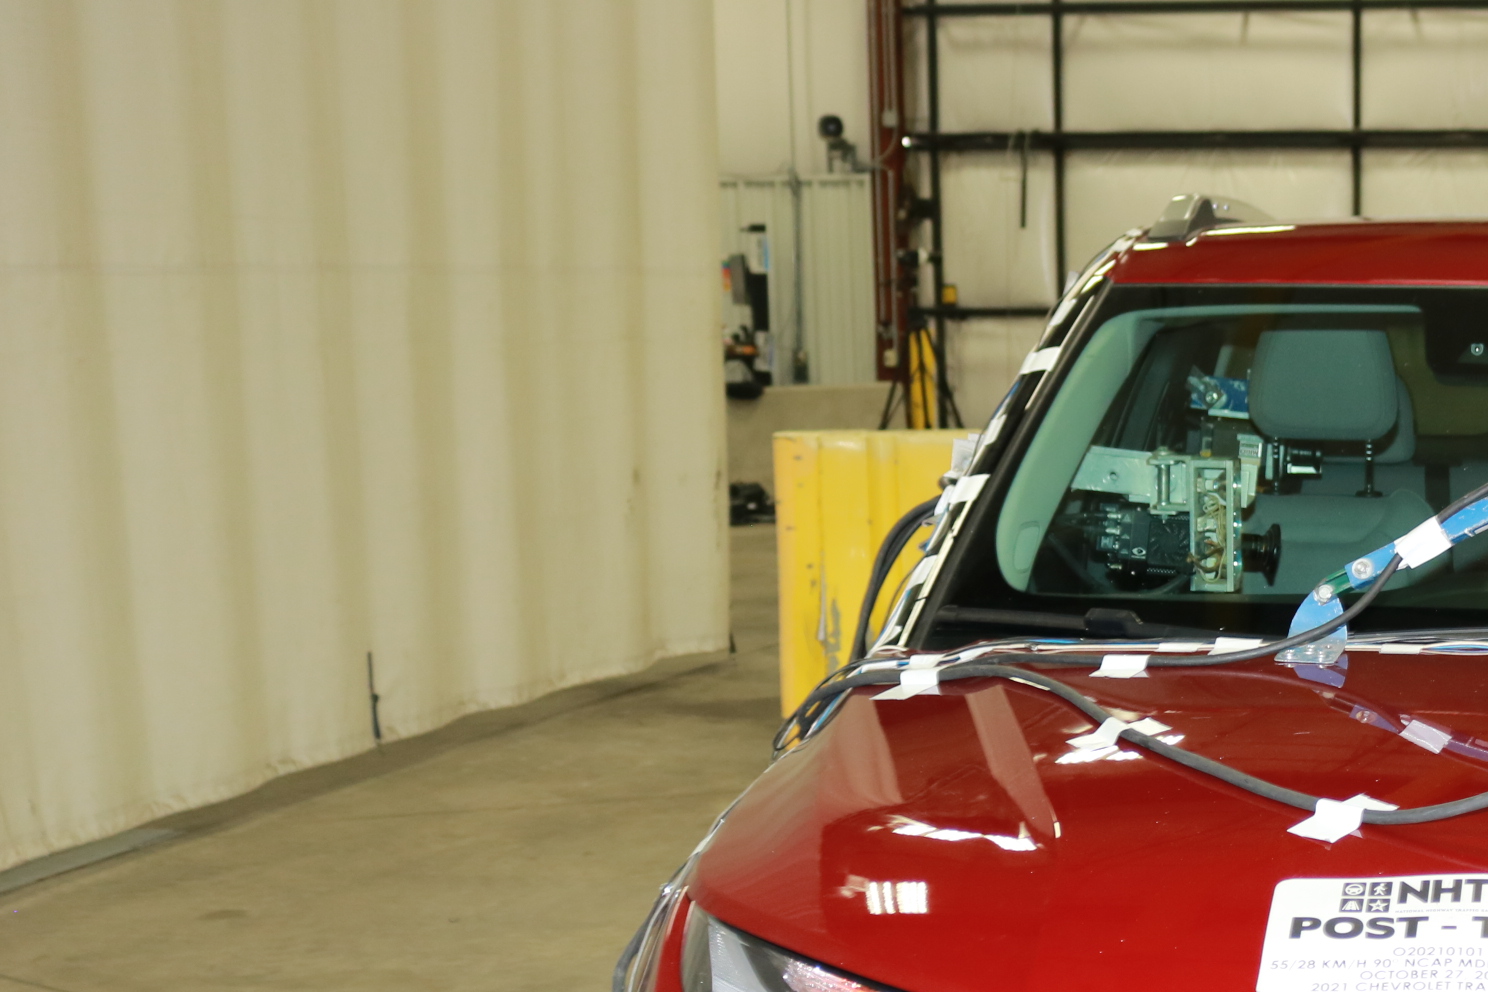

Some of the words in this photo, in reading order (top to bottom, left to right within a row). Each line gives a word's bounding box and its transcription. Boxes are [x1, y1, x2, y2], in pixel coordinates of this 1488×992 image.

[1289, 916, 1429, 939] POST
[1270, 960, 1316, 970] 55/28
[1322, 960, 1367, 969] KM/H
[1374, 959, 1399, 968] 90°
[1405, 958, 1452, 968] NCAP
[1360, 970, 1438, 980] OCTOBER
[1444, 970, 1467, 980] 27,
[1311, 983, 1348, 992] 2021
[1355, 981, 1451, 992] CHEVROLET
